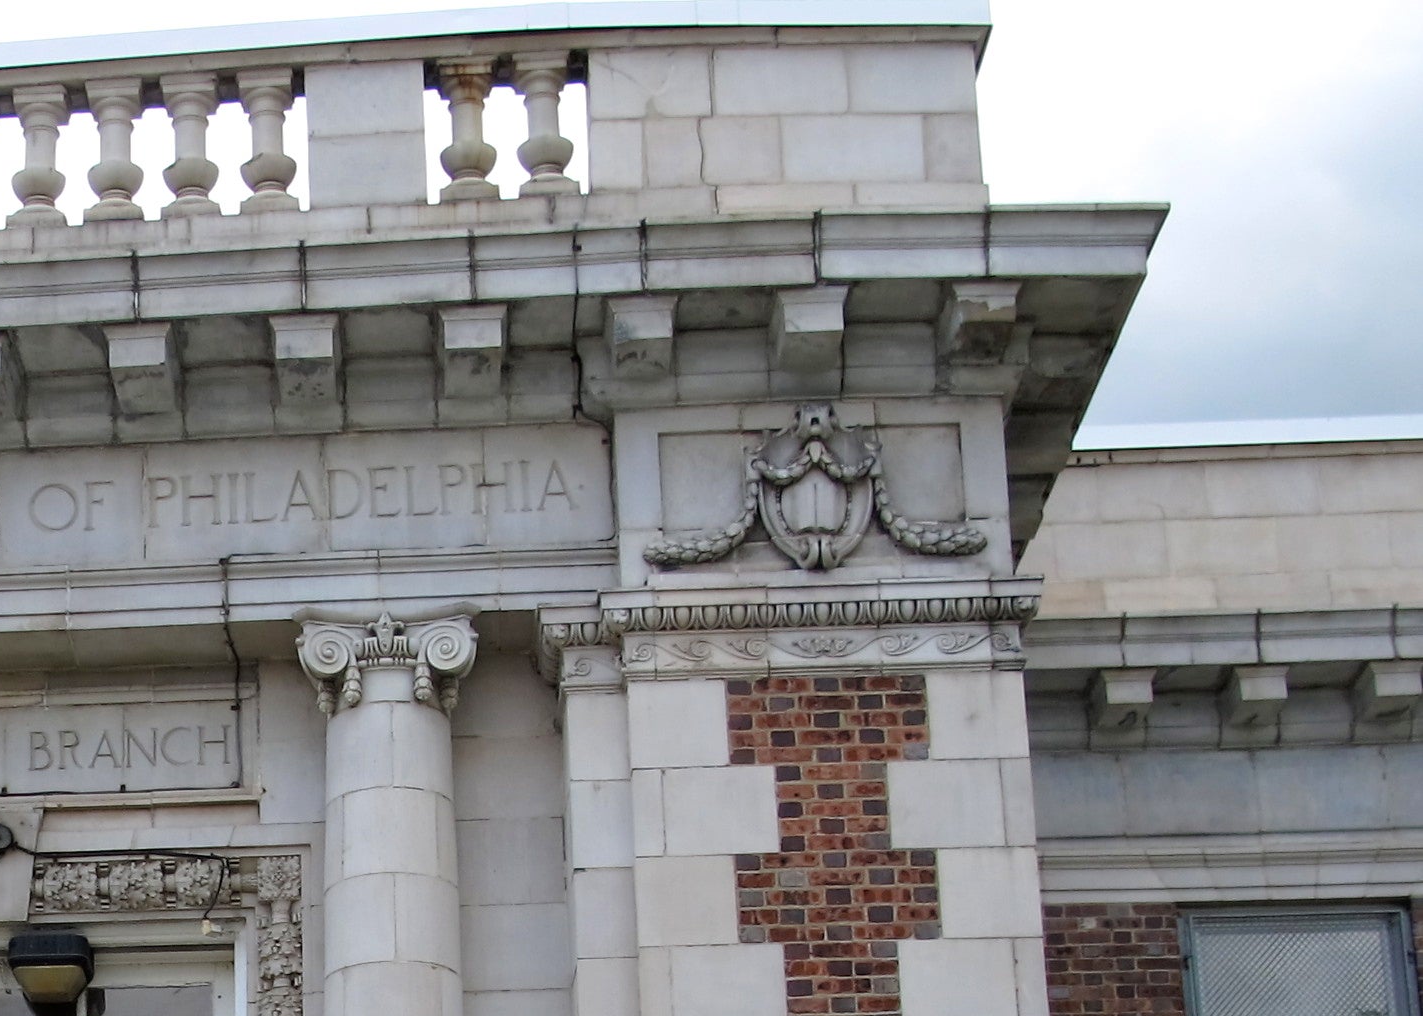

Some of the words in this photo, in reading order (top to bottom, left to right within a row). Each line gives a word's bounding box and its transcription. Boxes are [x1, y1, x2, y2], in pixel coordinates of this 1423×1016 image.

[28, 481, 115, 532] OF
[146, 459, 580, 530] PHILADELPHIA
[28, 724, 232, 771] BRANCH
